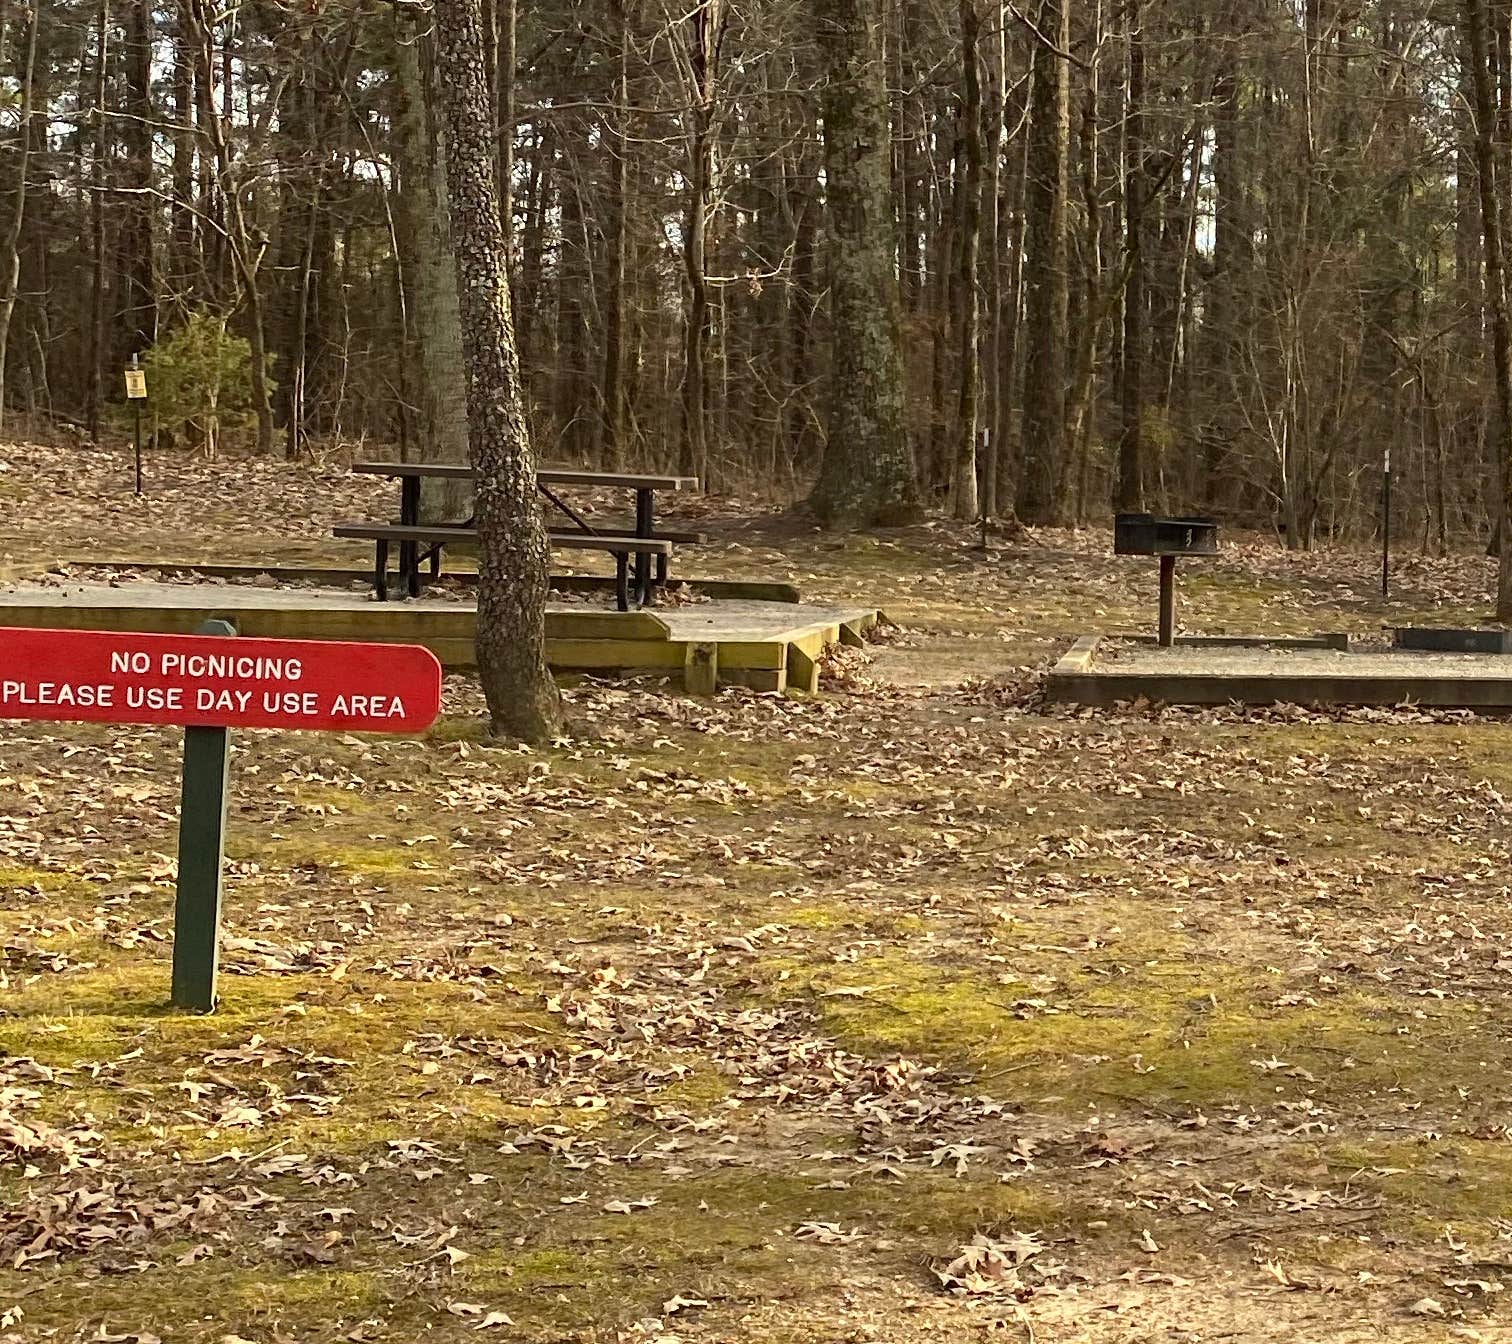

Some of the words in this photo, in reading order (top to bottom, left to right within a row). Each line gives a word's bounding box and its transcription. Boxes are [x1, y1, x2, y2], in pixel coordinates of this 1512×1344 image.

[111, 651, 151, 674] NO
[161, 653, 302, 680] PICNICING
[3, 680, 115, 707] PLEASE
[126, 686, 184, 710] USE
[196, 688, 253, 712] DAY
[263, 691, 319, 715] USE
[330, 694, 406, 718] AREA
